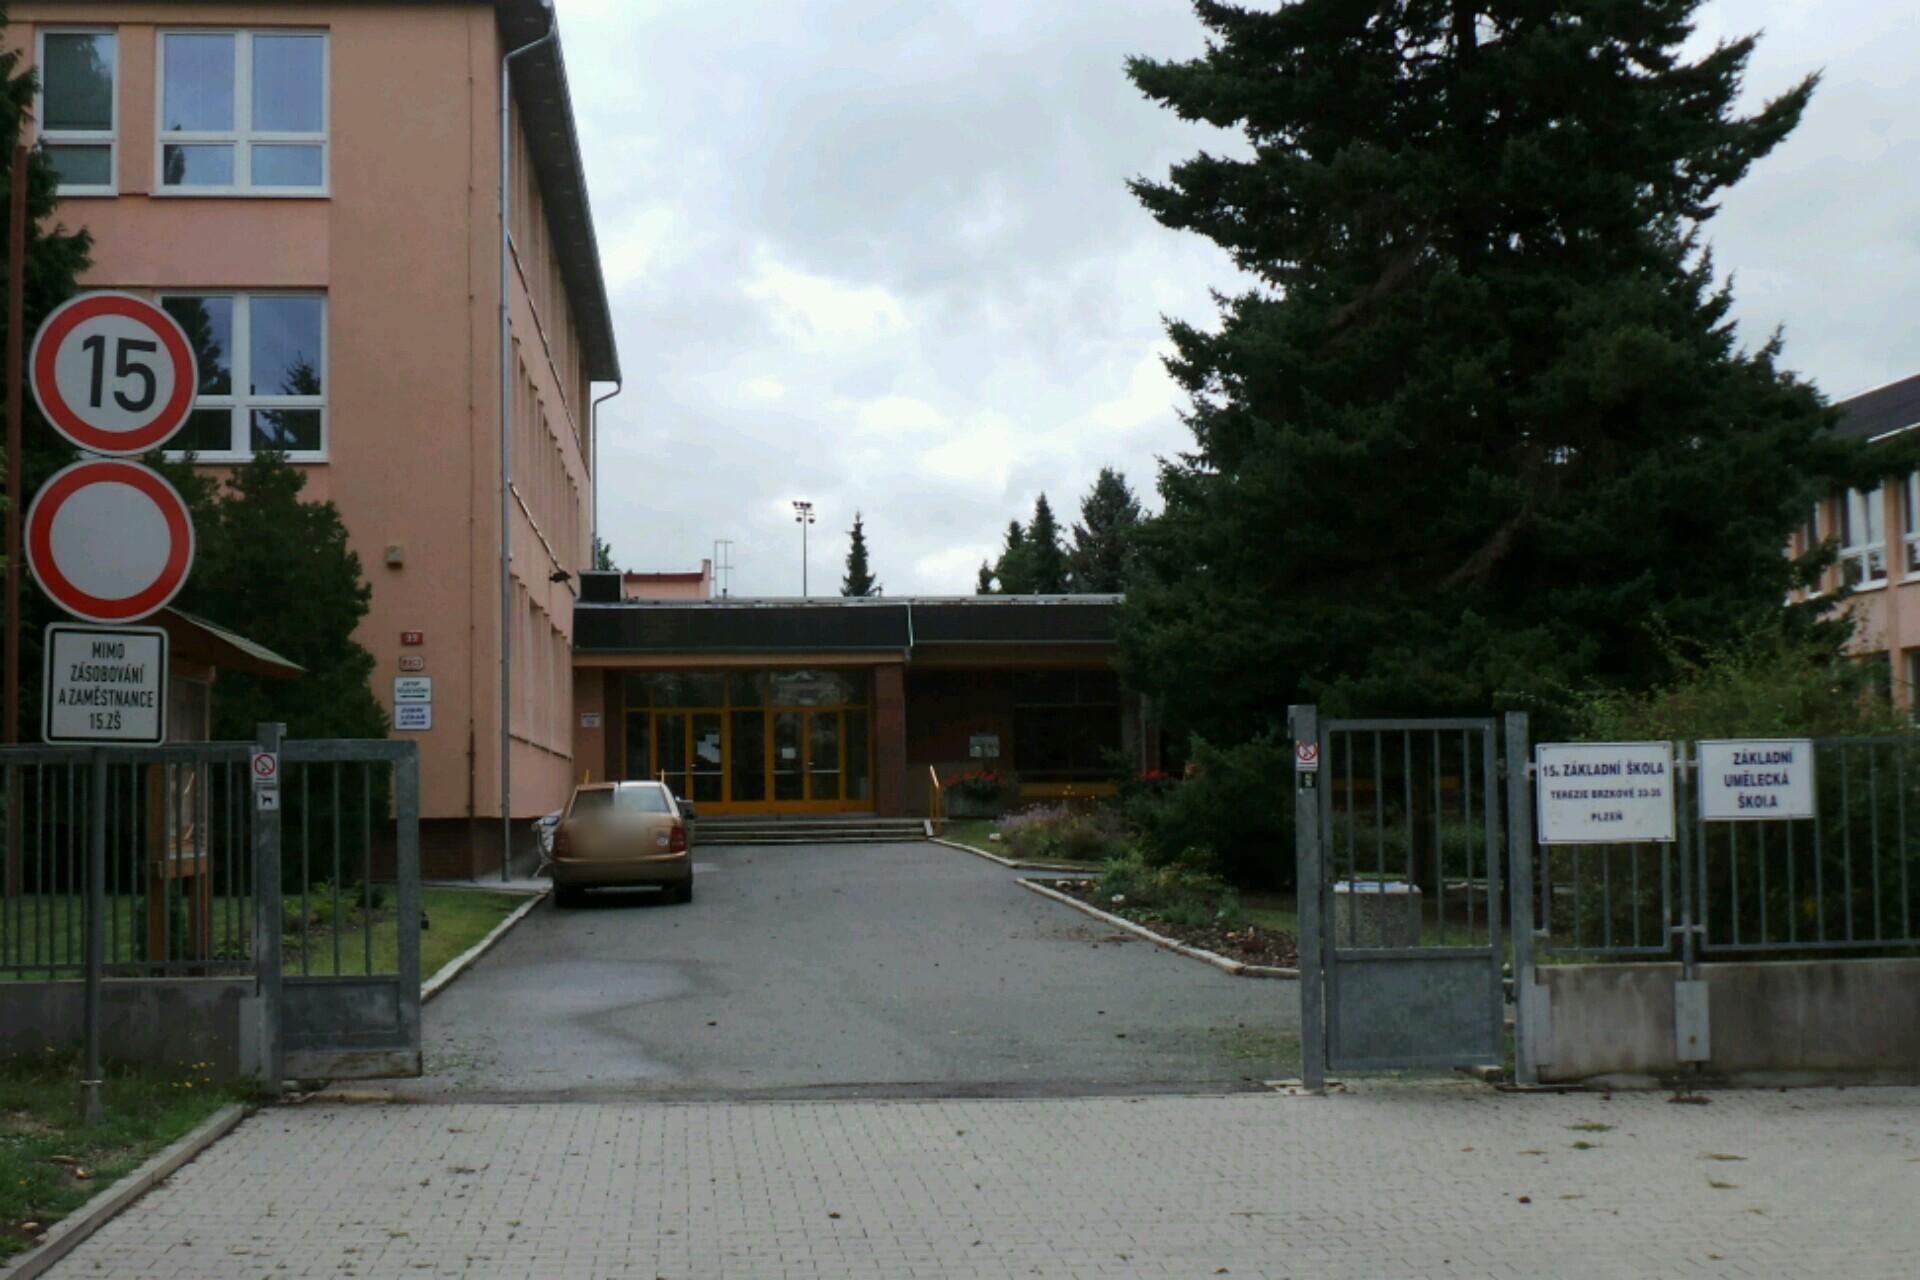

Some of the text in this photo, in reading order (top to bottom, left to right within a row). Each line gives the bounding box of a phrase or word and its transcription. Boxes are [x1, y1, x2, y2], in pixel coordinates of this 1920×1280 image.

[82, 334, 157, 412] 15
[91, 641, 125, 659] MIMO
[70, 661, 145, 684] ZÁSOBOVÁNÍ
[58, 685, 154, 708] A ZAMĚSTNANCE
[1733, 747, 1793, 765] ZÁKLADNÍ
[1542, 759, 1665, 777] 15. ZÁKLADNÍ ŠKOLA
[1724, 768, 1791, 787] UMĚLECKÁ
[1550, 789, 1589, 800] TEREZIE
[1591, 787, 1634, 799] BRZKOVÉ
[1738, 792, 1778, 809] ŠKOLA
[1591, 810, 1623, 822] PLZEŇ
